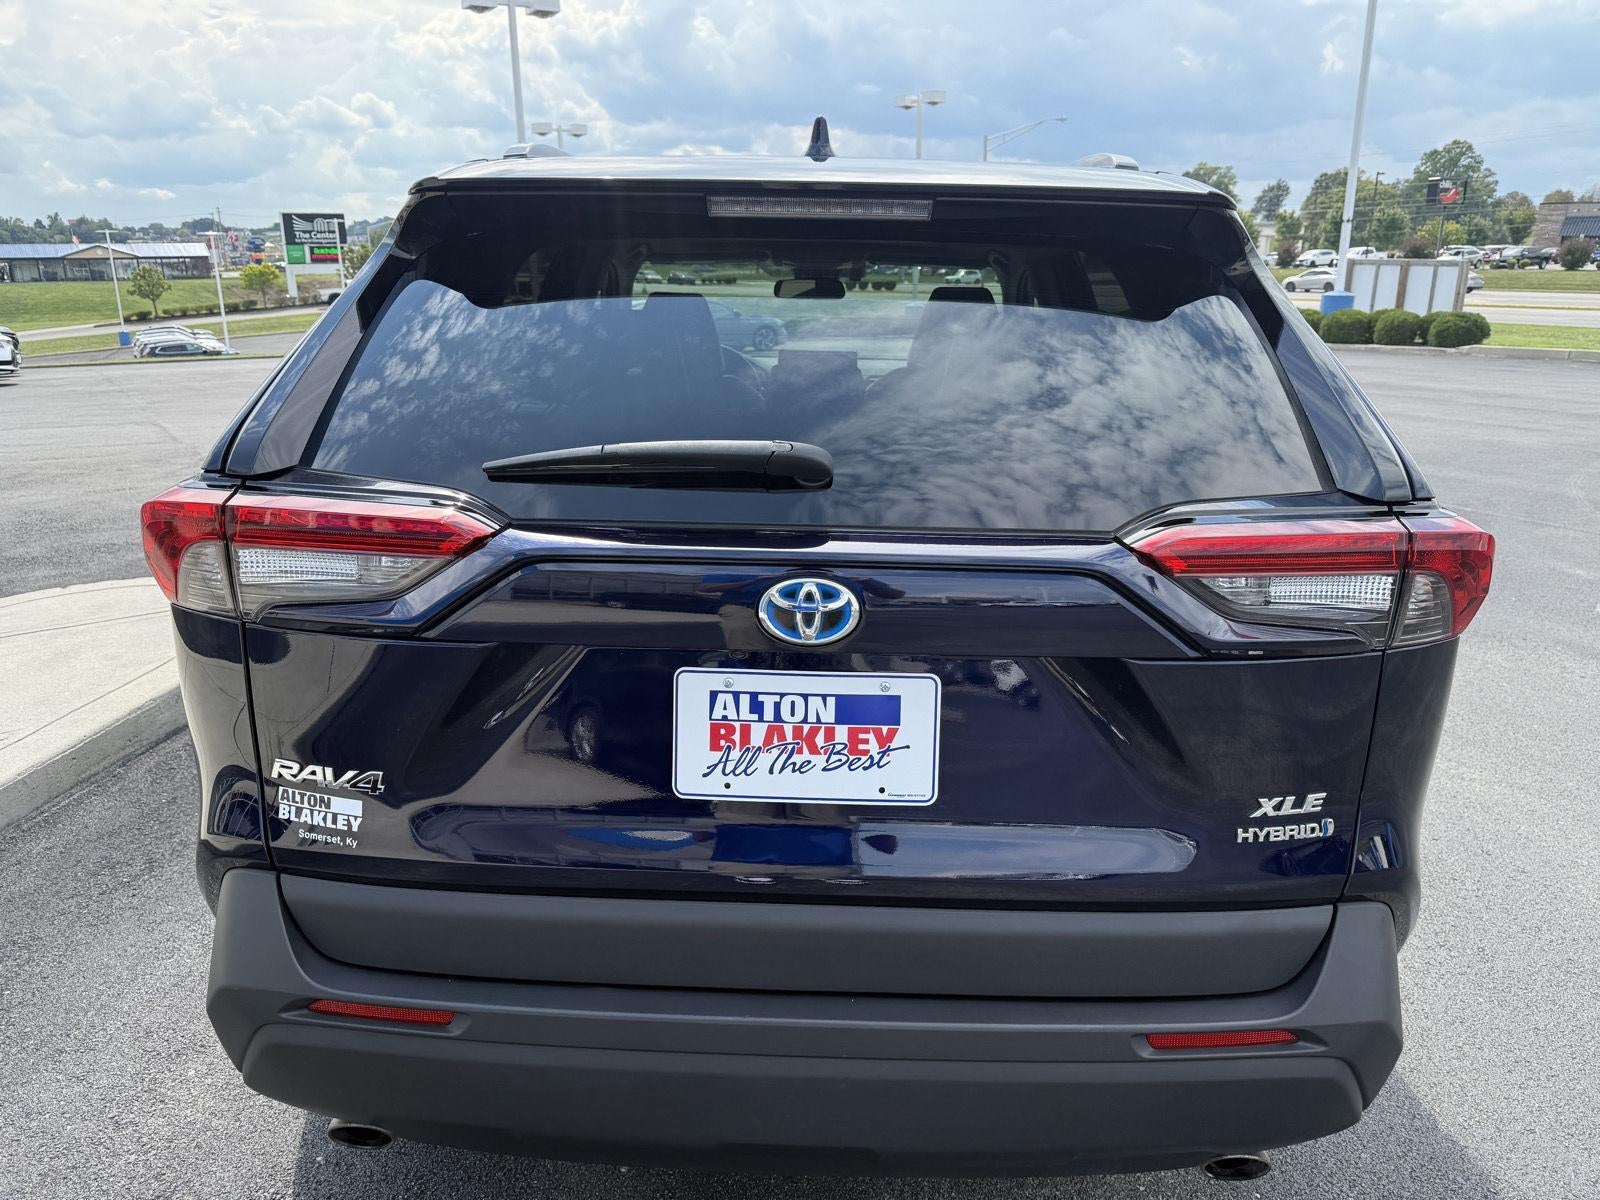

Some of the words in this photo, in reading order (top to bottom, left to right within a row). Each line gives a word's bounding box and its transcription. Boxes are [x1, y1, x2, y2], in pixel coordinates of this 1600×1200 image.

[294, 231, 310, 239] The
[310, 231, 337, 239] Center
[710, 692, 836, 724] ALTON
[709, 721, 901, 758] BLAKLEY
[701, 744, 762, 778] All
[765, 741, 817, 775] The
[819, 742, 911, 773] Best
[270, 758, 385, 795] RAV4
[279, 787, 332, 811] ALTON
[1248, 792, 1328, 818] XLE
[278, 803, 363, 832] BLAKLEY
[298, 829, 344, 847] Somerset,
[345, 836, 358, 849] Ky
[1236, 822, 1322, 843] HYBRID
